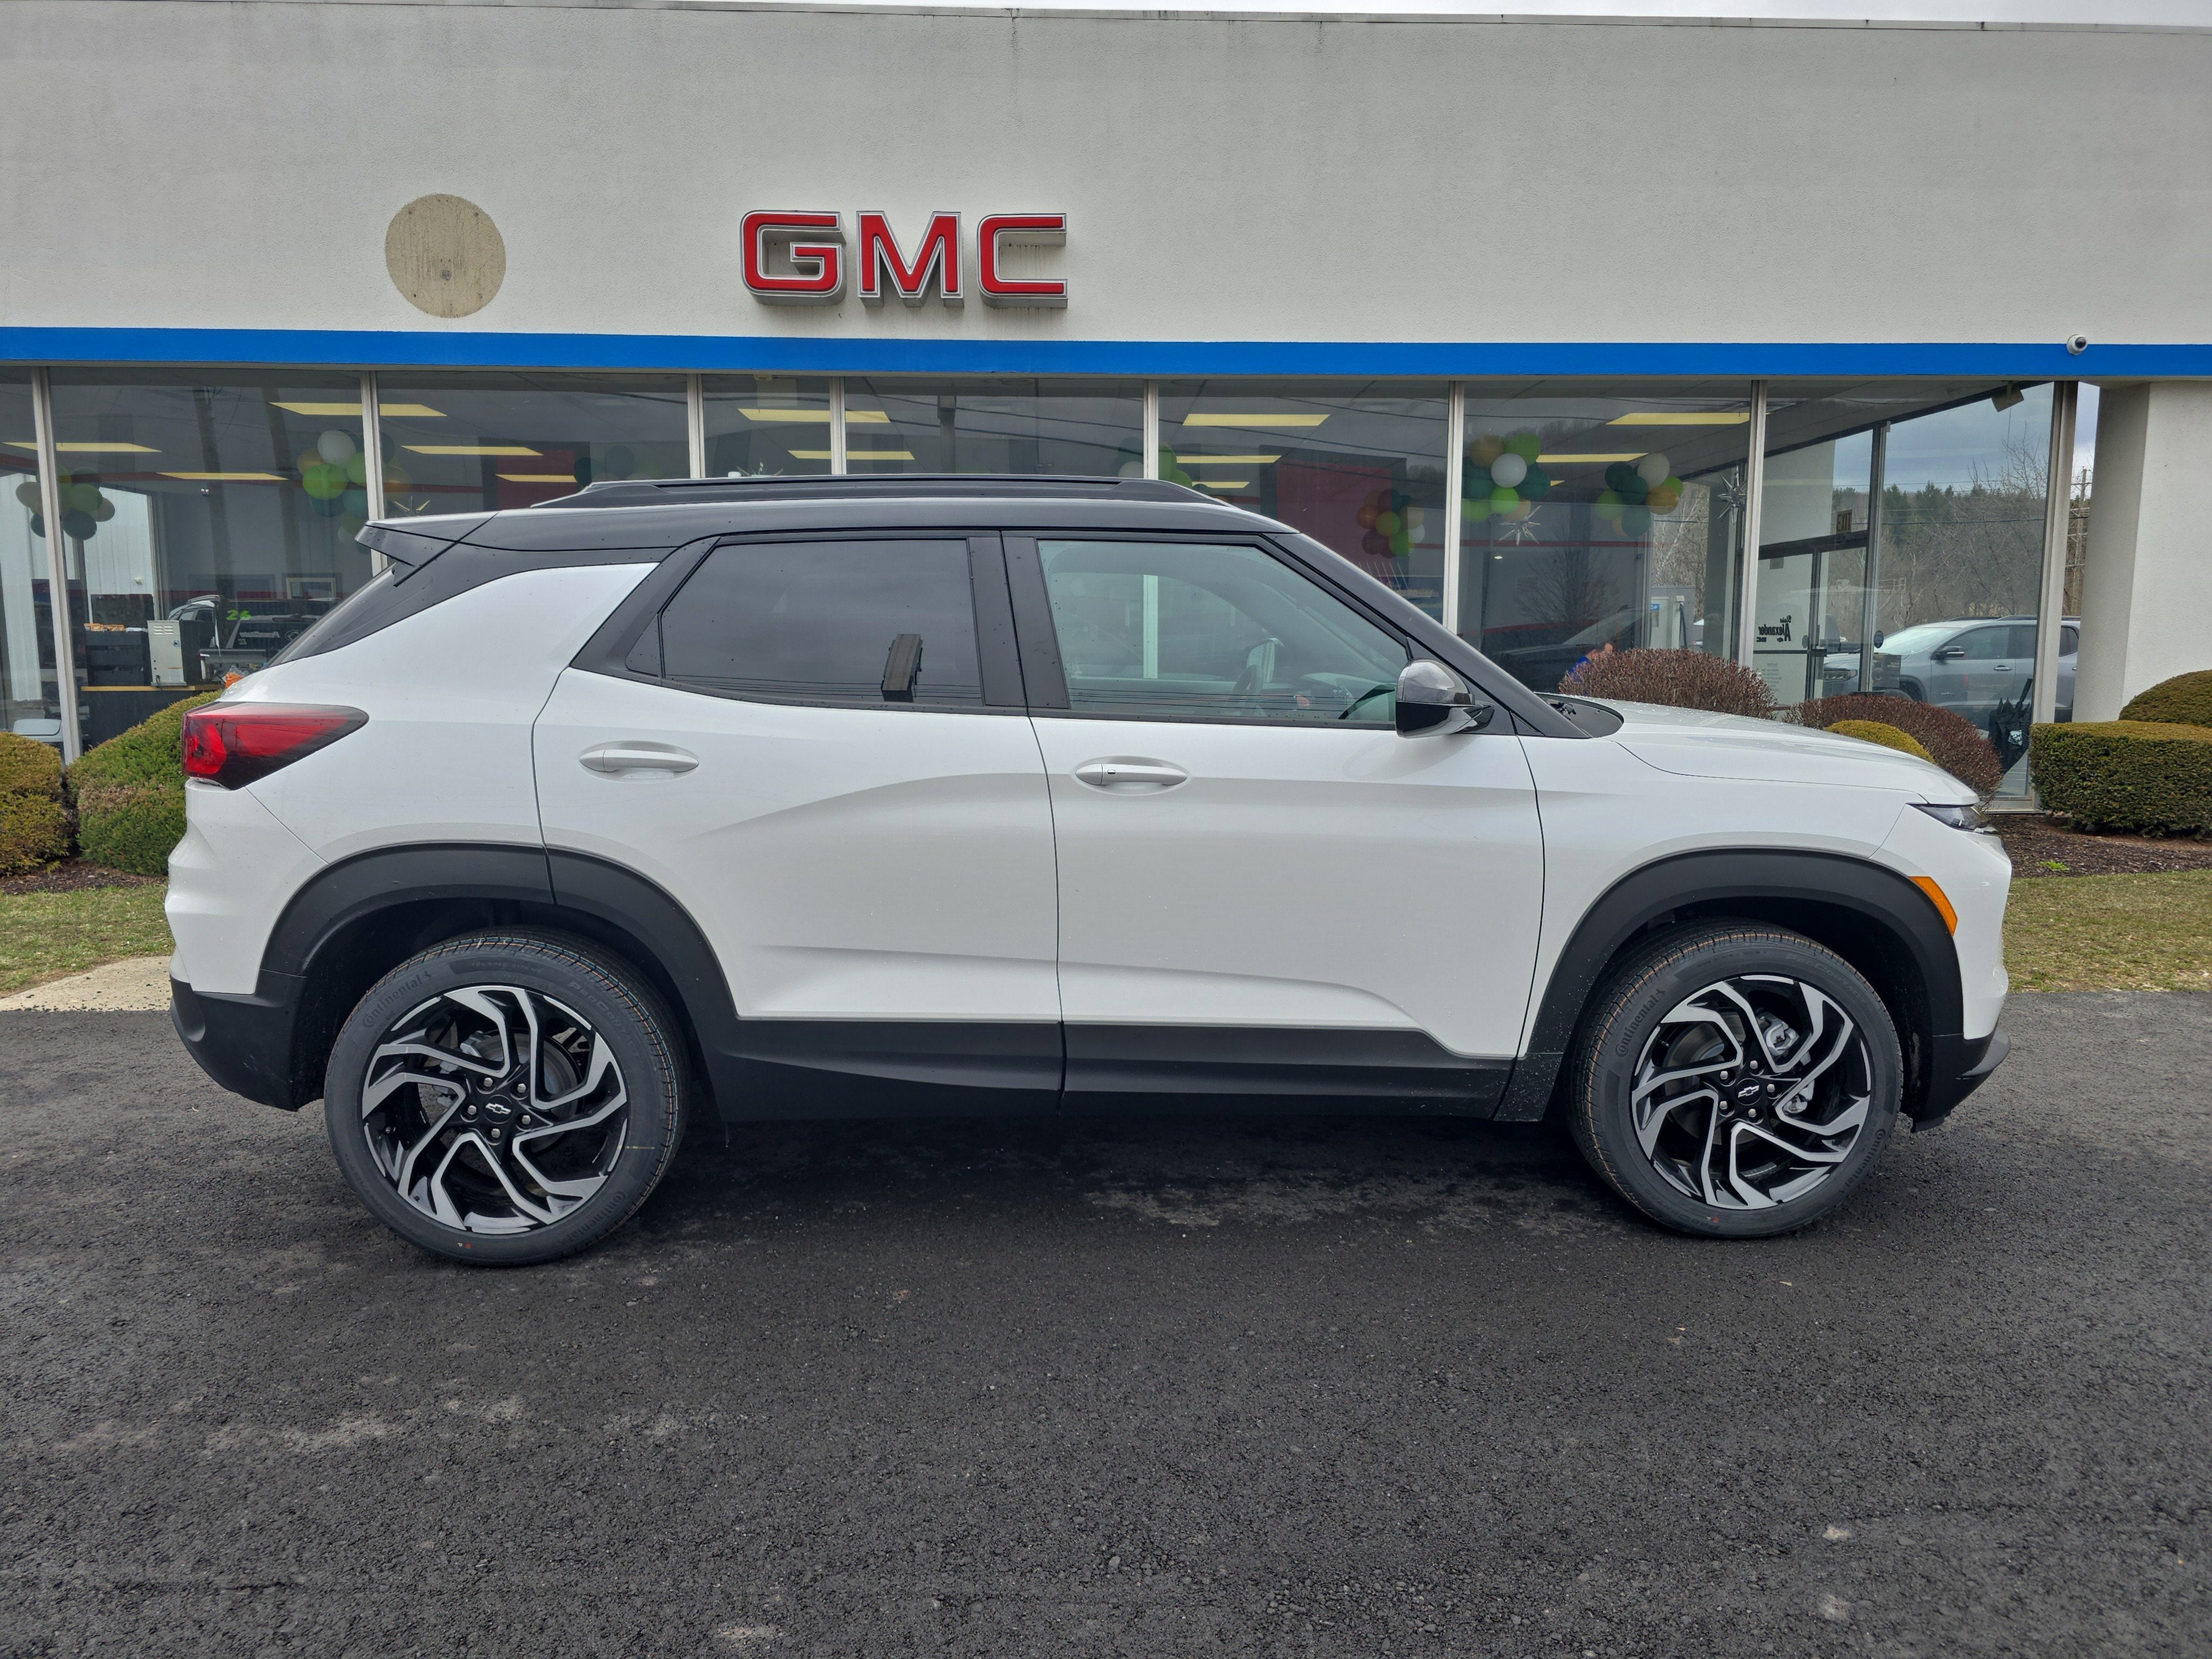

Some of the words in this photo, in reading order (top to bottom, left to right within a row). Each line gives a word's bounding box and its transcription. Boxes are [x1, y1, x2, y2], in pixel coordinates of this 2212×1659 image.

[741, 210, 1068, 304] GMC
[362, 976, 423, 1029] Continental
[1615, 994, 1658, 1057] Continental
[1845, 1128, 1887, 1189] Continental
[567, 1191, 627, 1242] Continental
